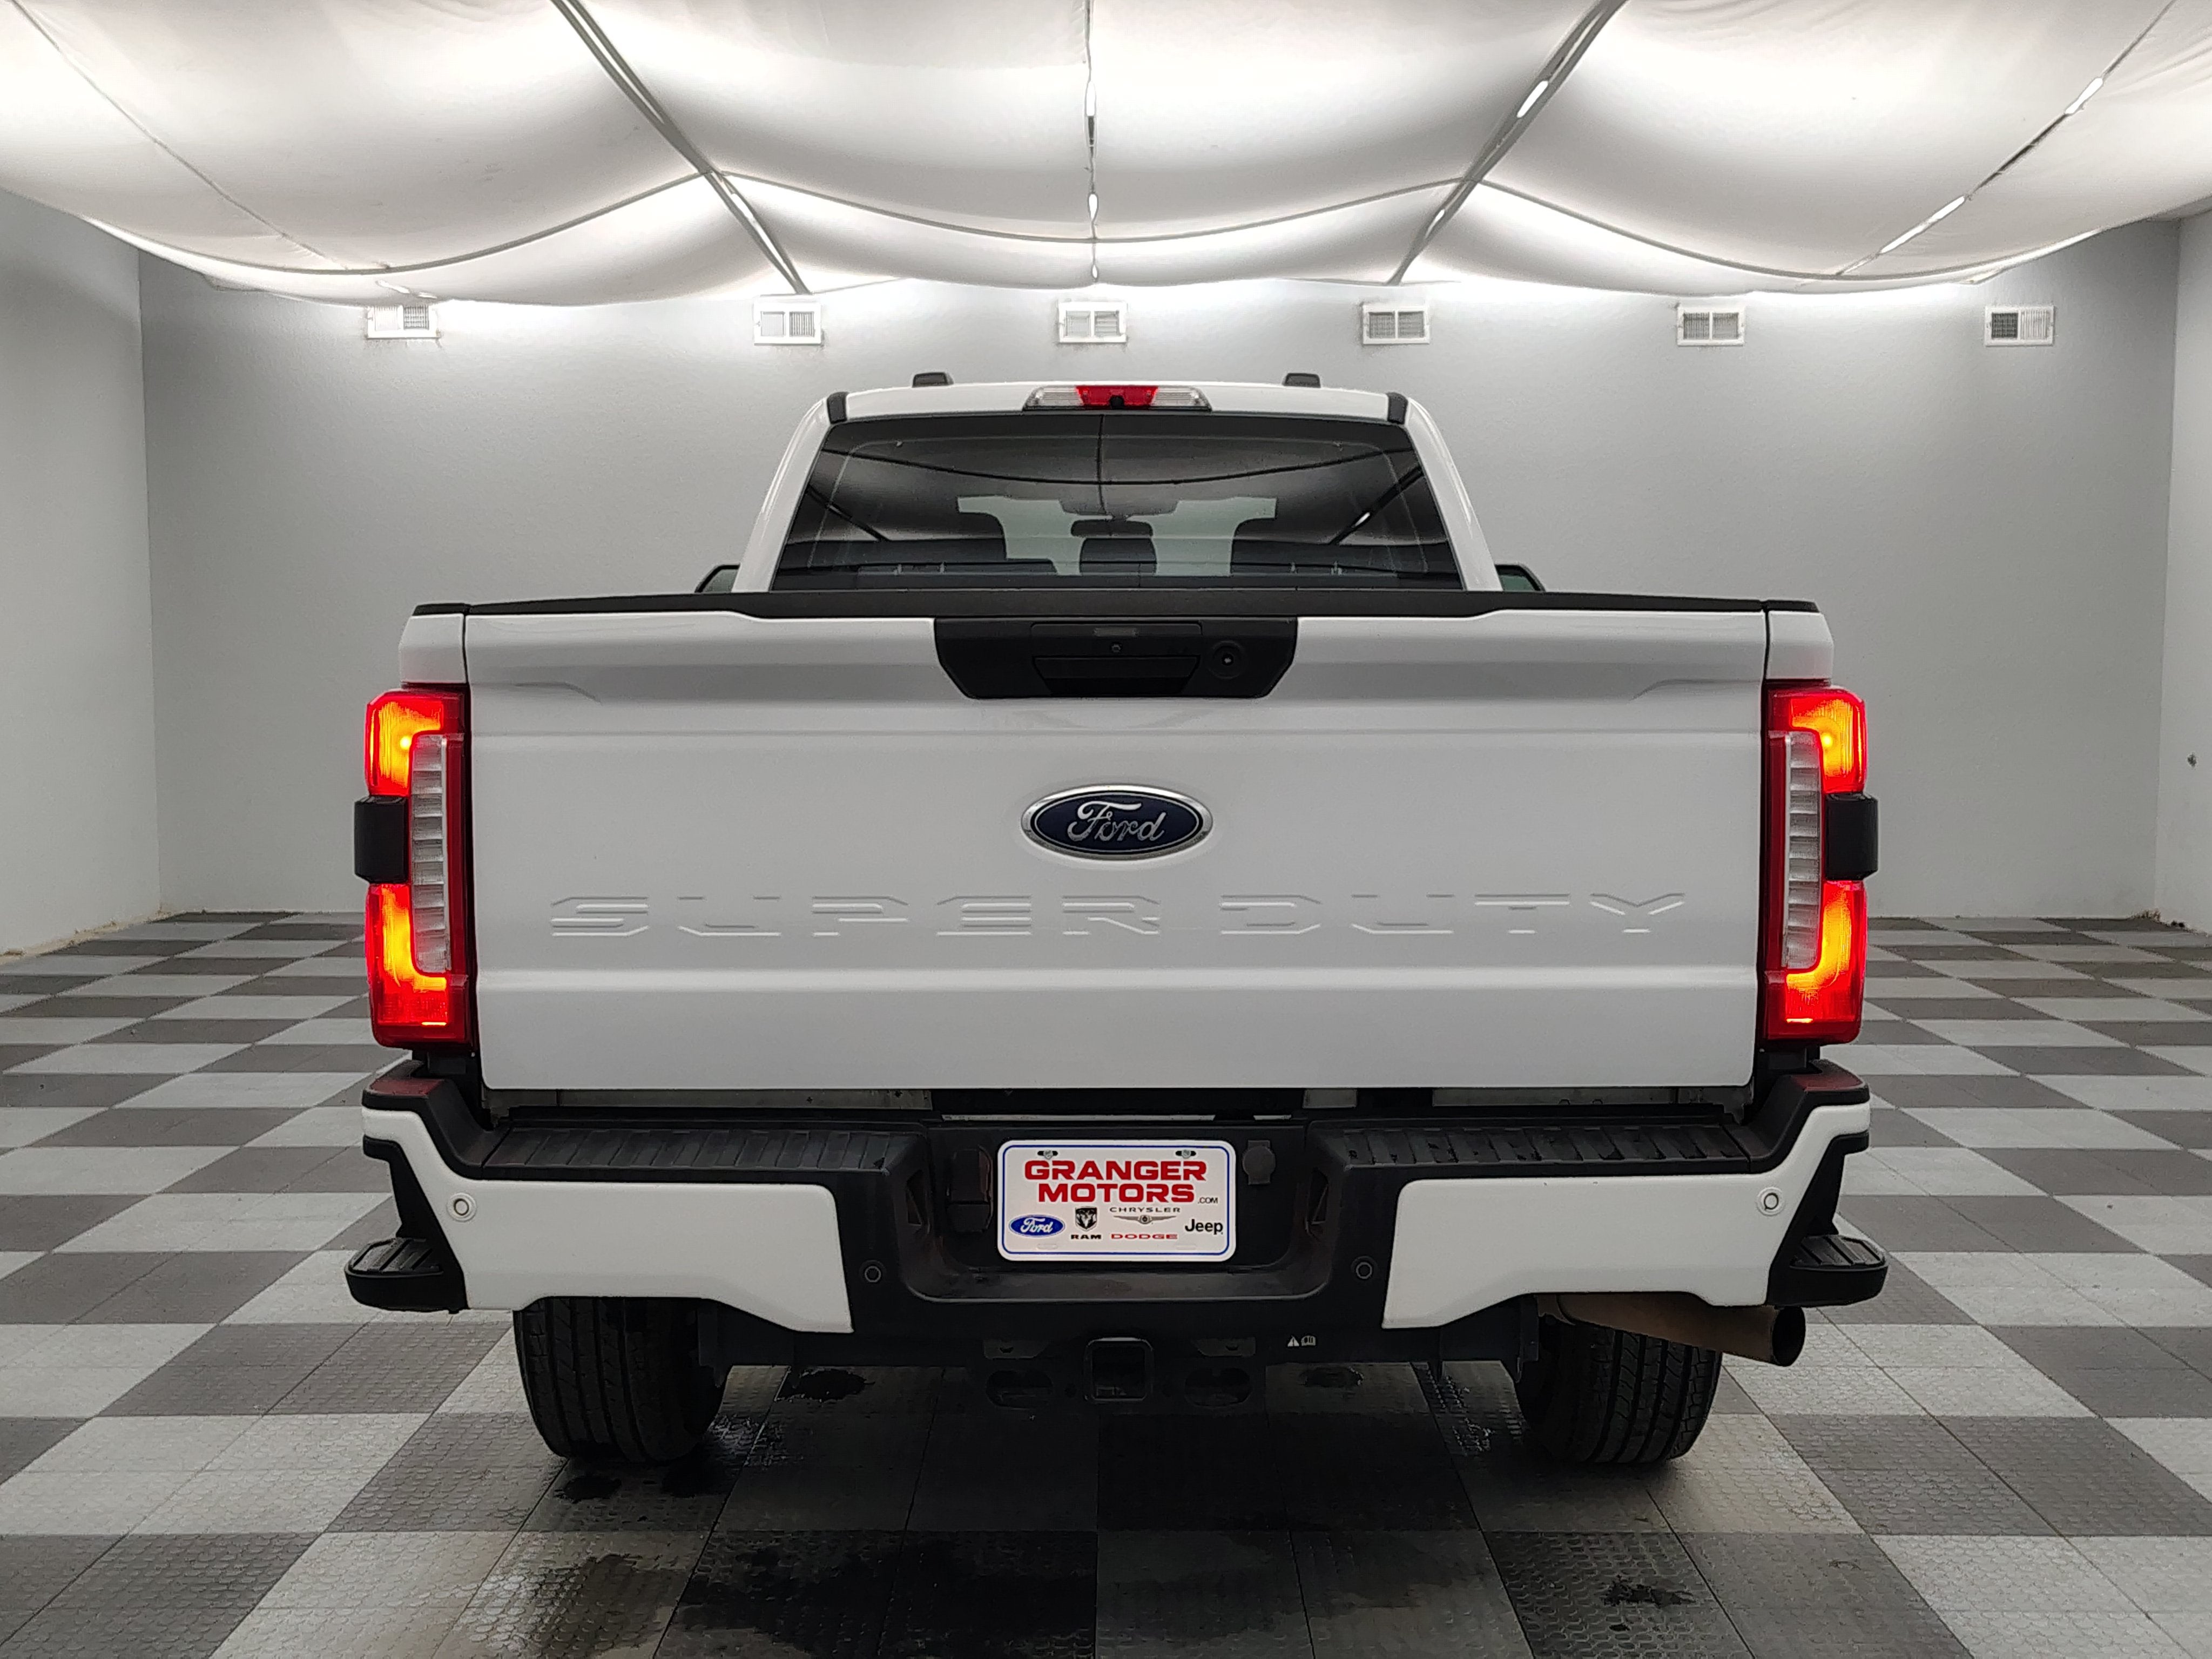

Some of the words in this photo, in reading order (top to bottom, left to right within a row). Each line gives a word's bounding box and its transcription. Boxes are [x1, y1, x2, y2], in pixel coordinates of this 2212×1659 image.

[1067, 800, 1167, 841] Ford
[550, 895, 1161, 938] SUPER
[1219, 893, 1685, 935] DUTY
[1024, 1160, 1207, 1181] GRANGER
[1038, 1183, 1195, 1203] MOTORS
[1020, 1217, 1054, 1235] Ford
[1184, 1219, 1224, 1235] Jeep
